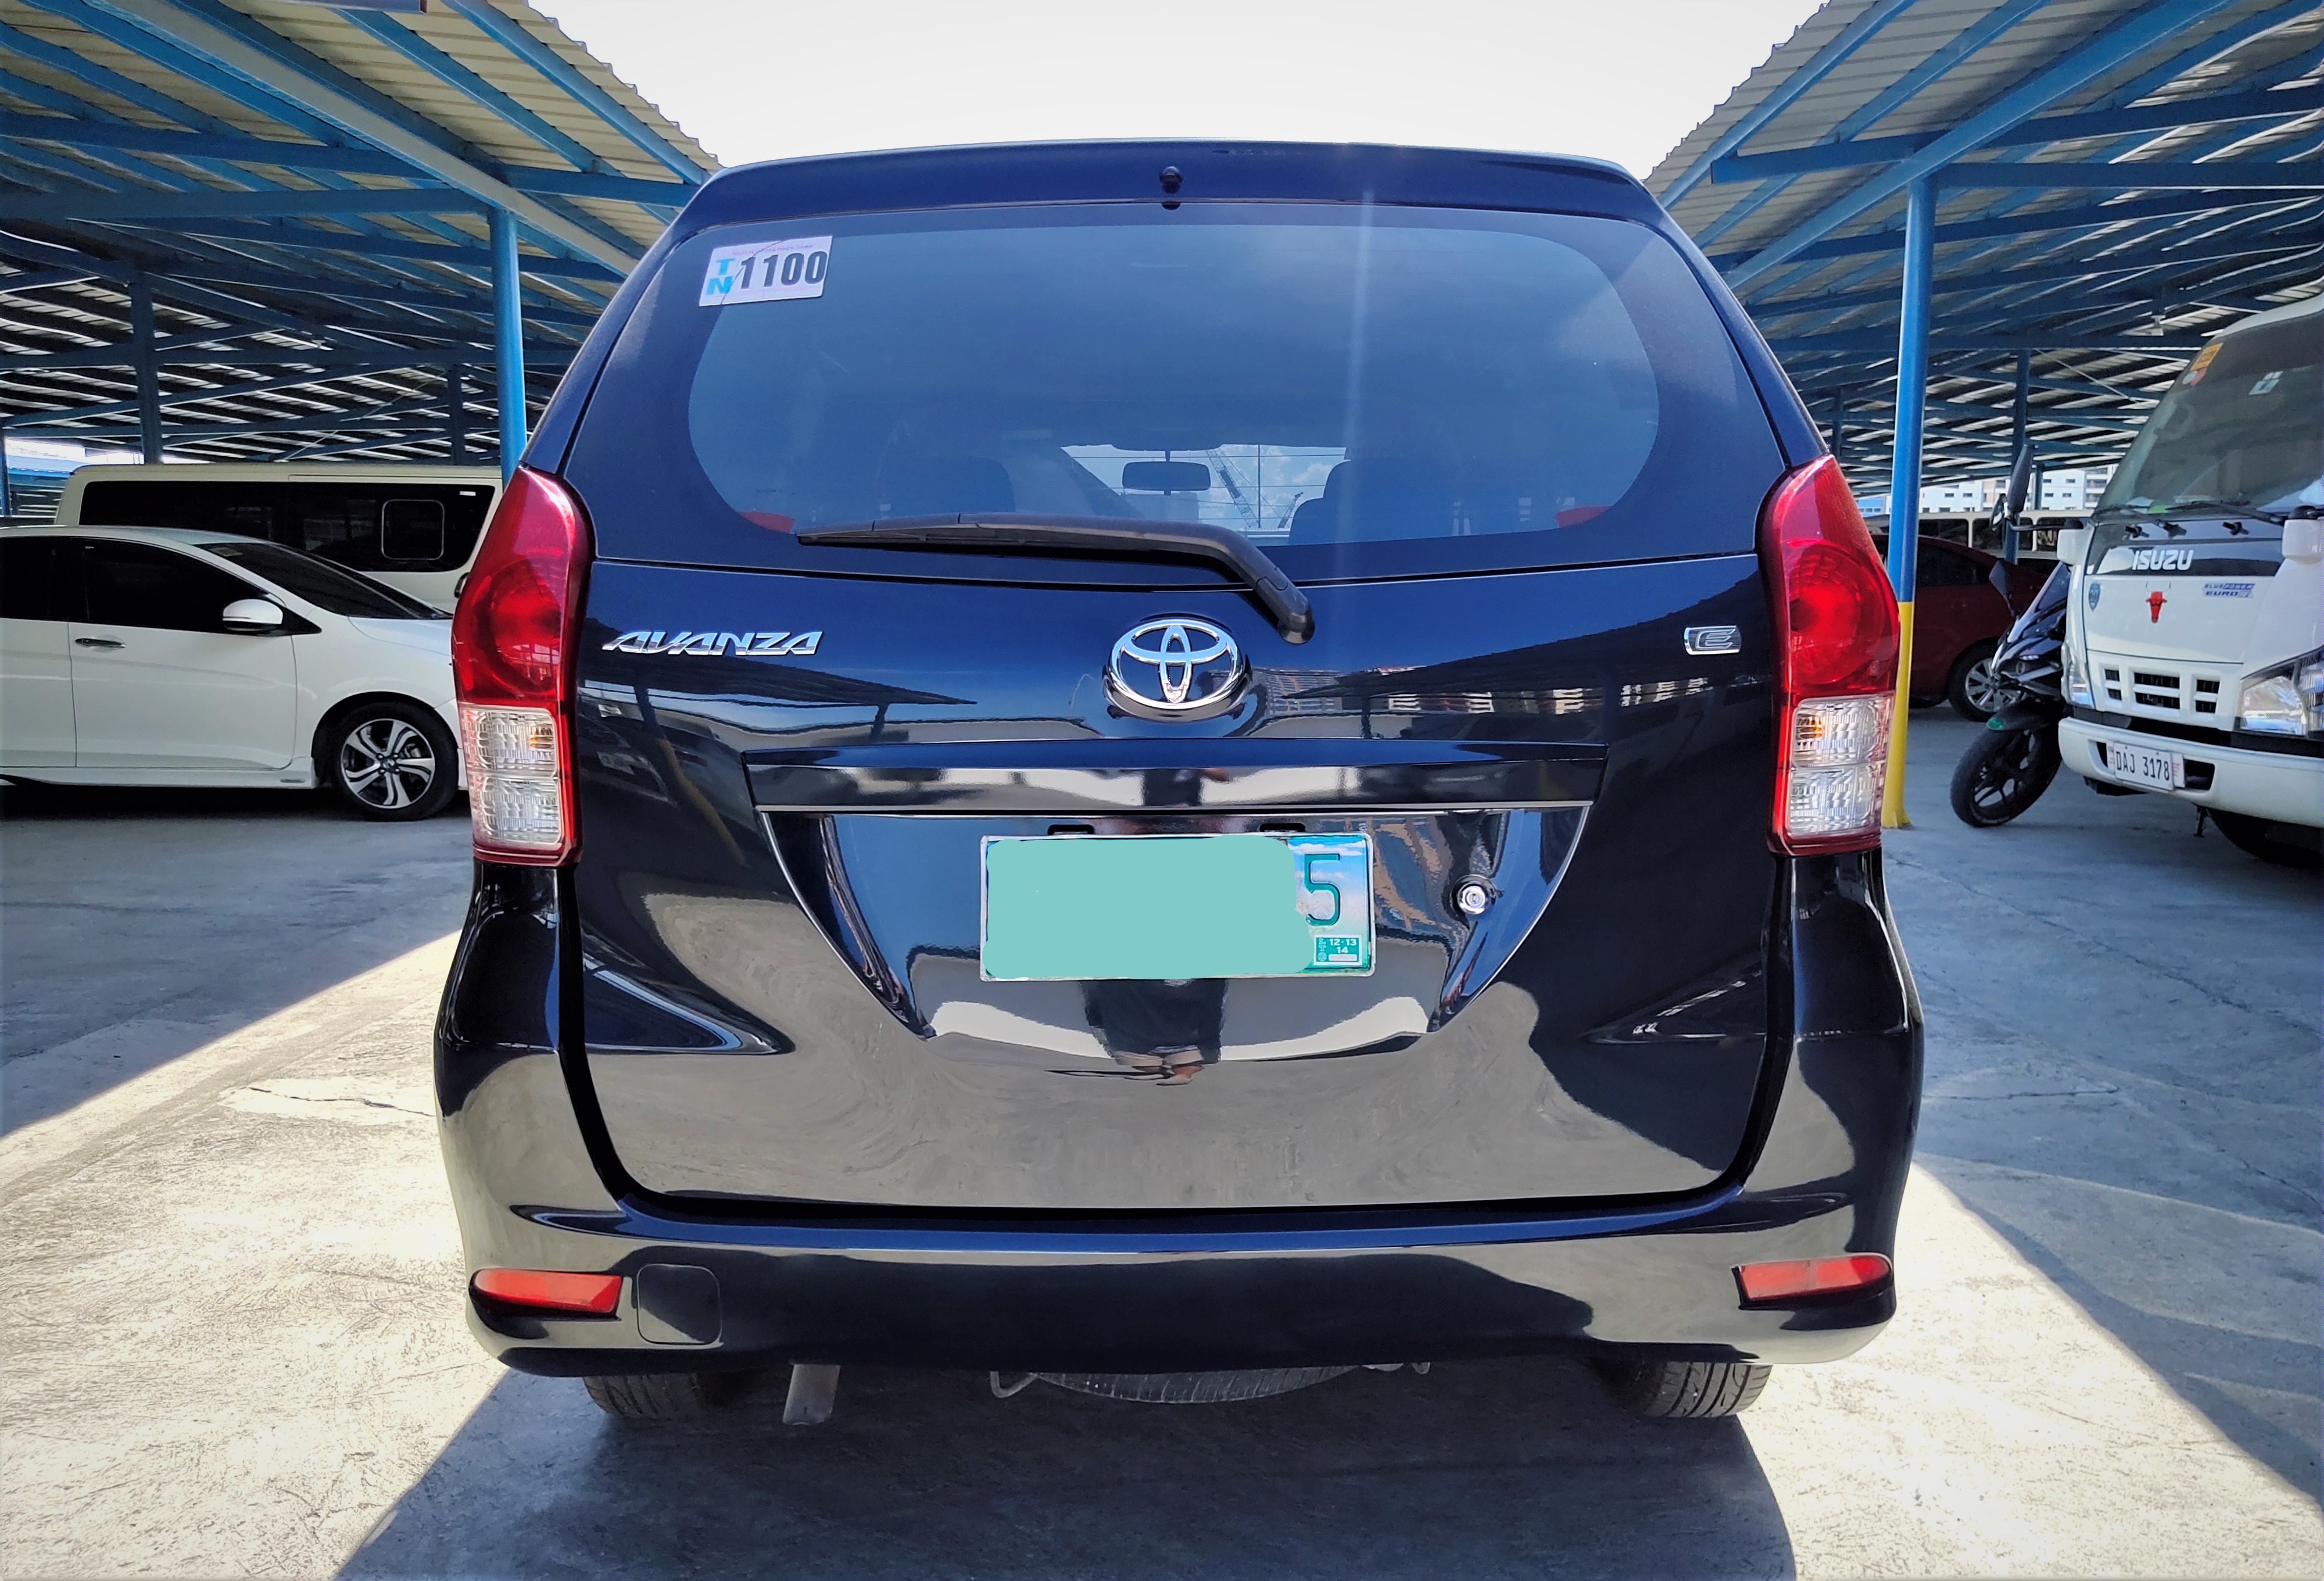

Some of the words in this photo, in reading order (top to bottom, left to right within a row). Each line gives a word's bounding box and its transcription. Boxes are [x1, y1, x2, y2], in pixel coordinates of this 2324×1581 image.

[740, 251, 828, 289] 1100
[2132, 549, 2194, 570] ISUZU
[601, 631, 823, 655] AVANZA
[2116, 750, 2136, 774] DAJ
[2142, 756, 2170, 781] 3178
[1304, 853, 1341, 926] 5
